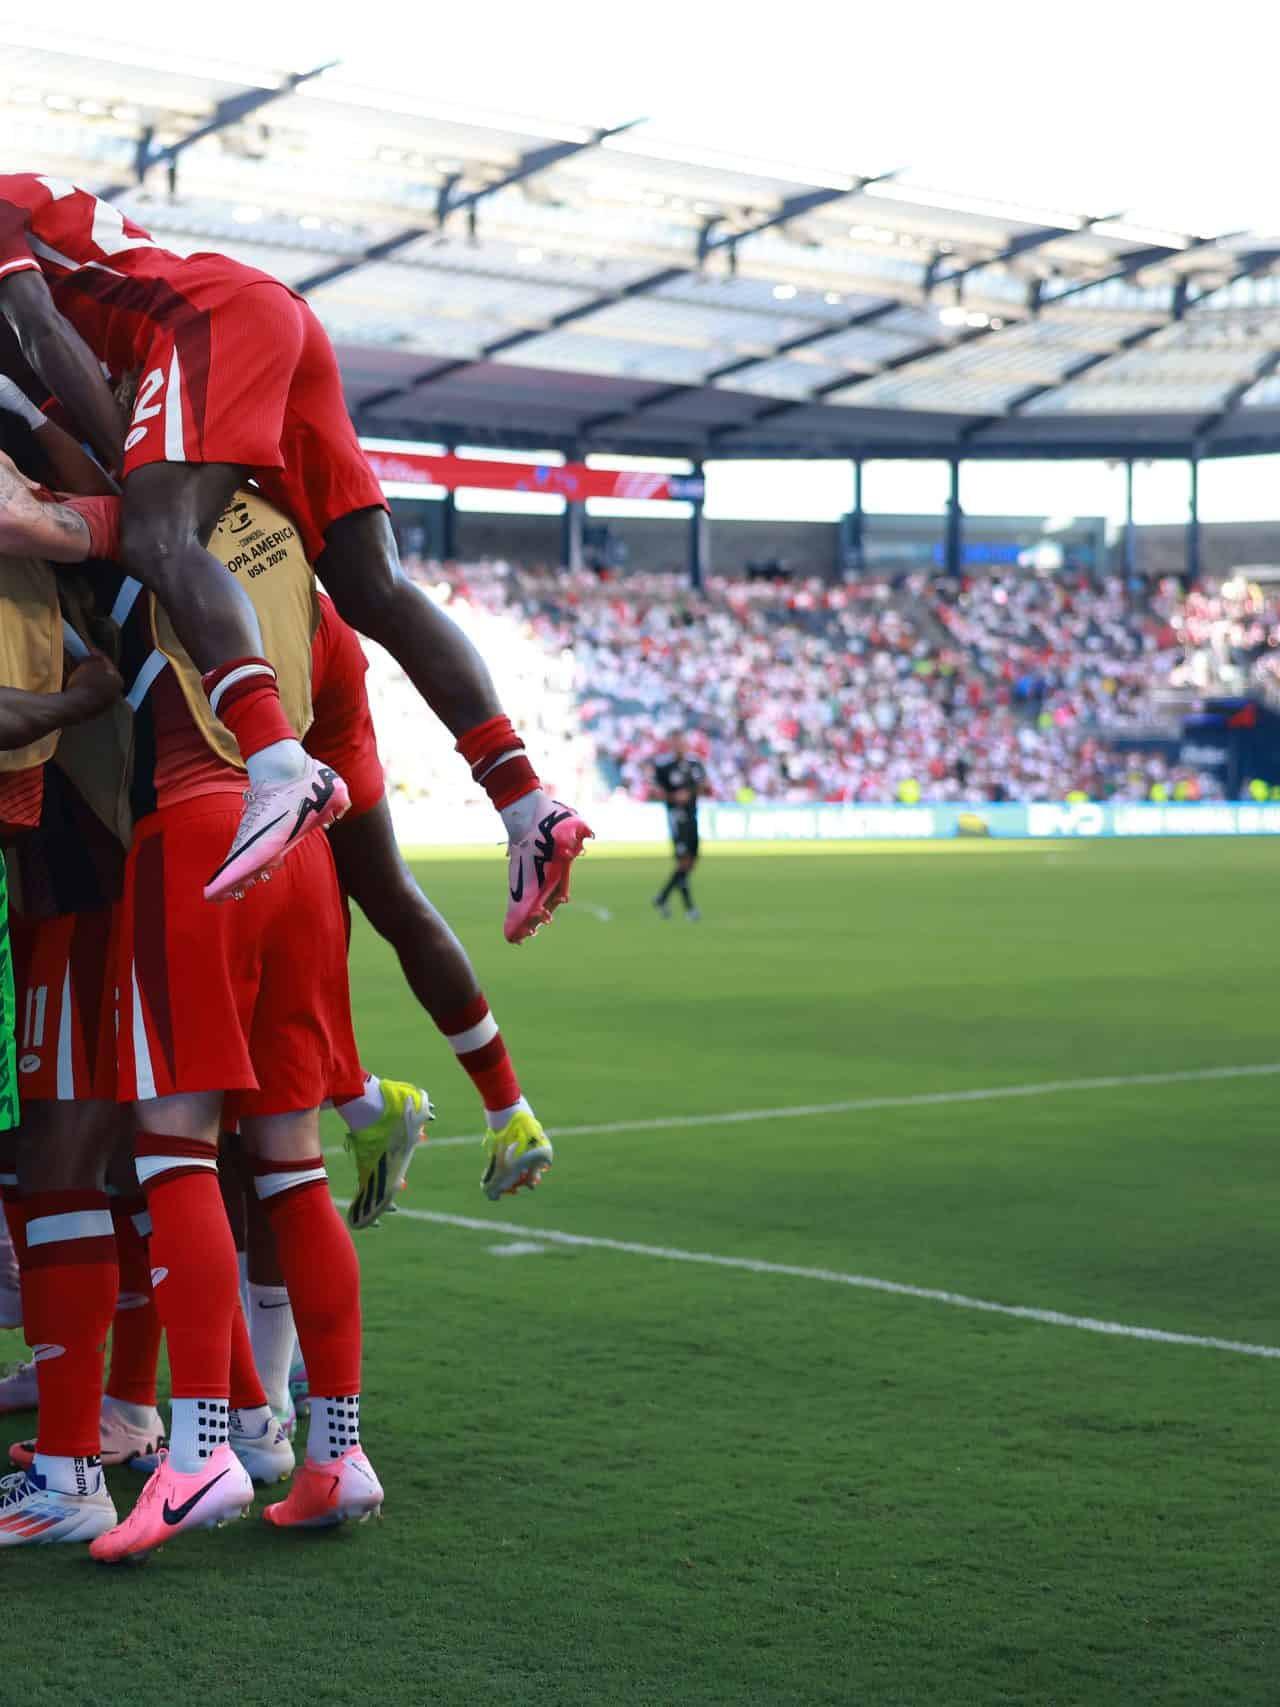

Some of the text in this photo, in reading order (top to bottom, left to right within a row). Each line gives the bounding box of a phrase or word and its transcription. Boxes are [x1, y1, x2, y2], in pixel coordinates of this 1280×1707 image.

[224, 552, 251, 573] OPA
[247, 548, 288, 579] USA 2024
[73, 1456, 89, 1497] ESIGN
